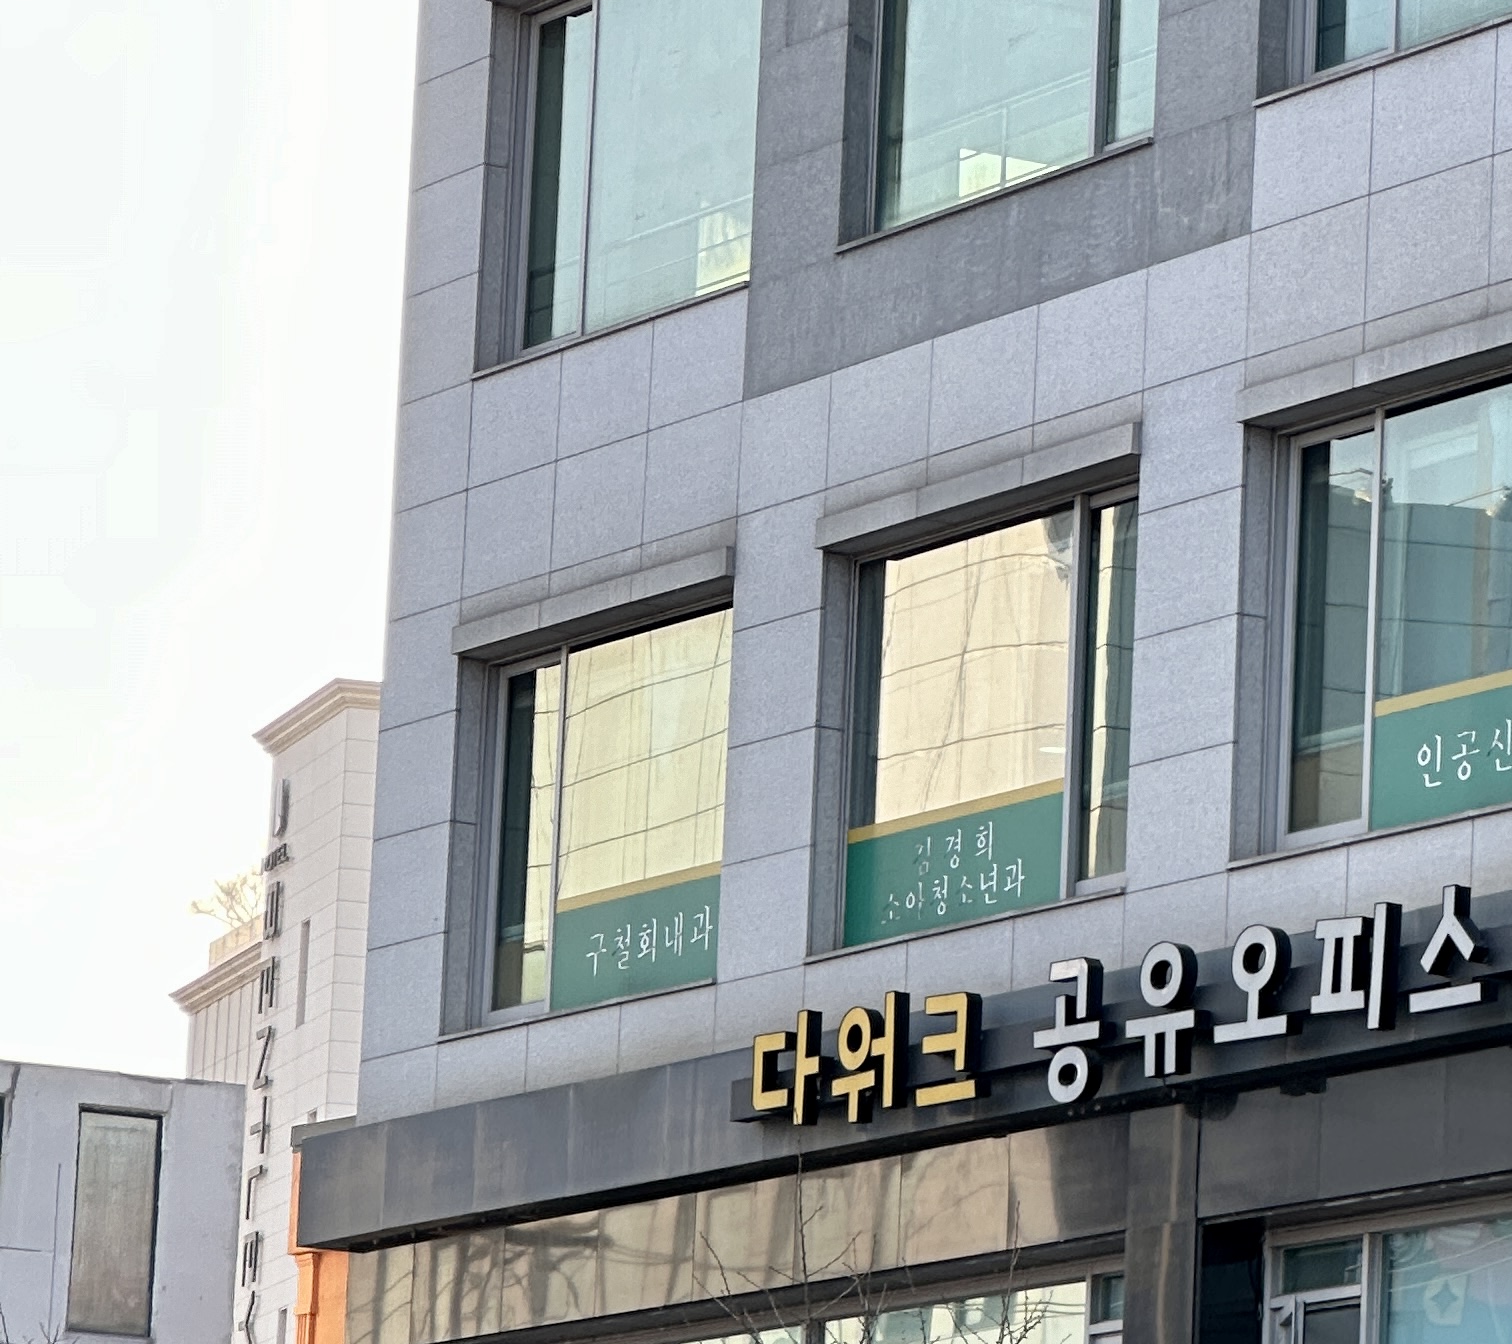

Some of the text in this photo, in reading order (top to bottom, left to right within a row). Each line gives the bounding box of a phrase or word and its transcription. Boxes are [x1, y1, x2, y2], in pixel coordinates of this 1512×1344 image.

[881, 858, 1026, 924] 소아청소년과
[586, 905, 714, 976] 구철회내과
[752, 991, 980, 1125] 다워크
